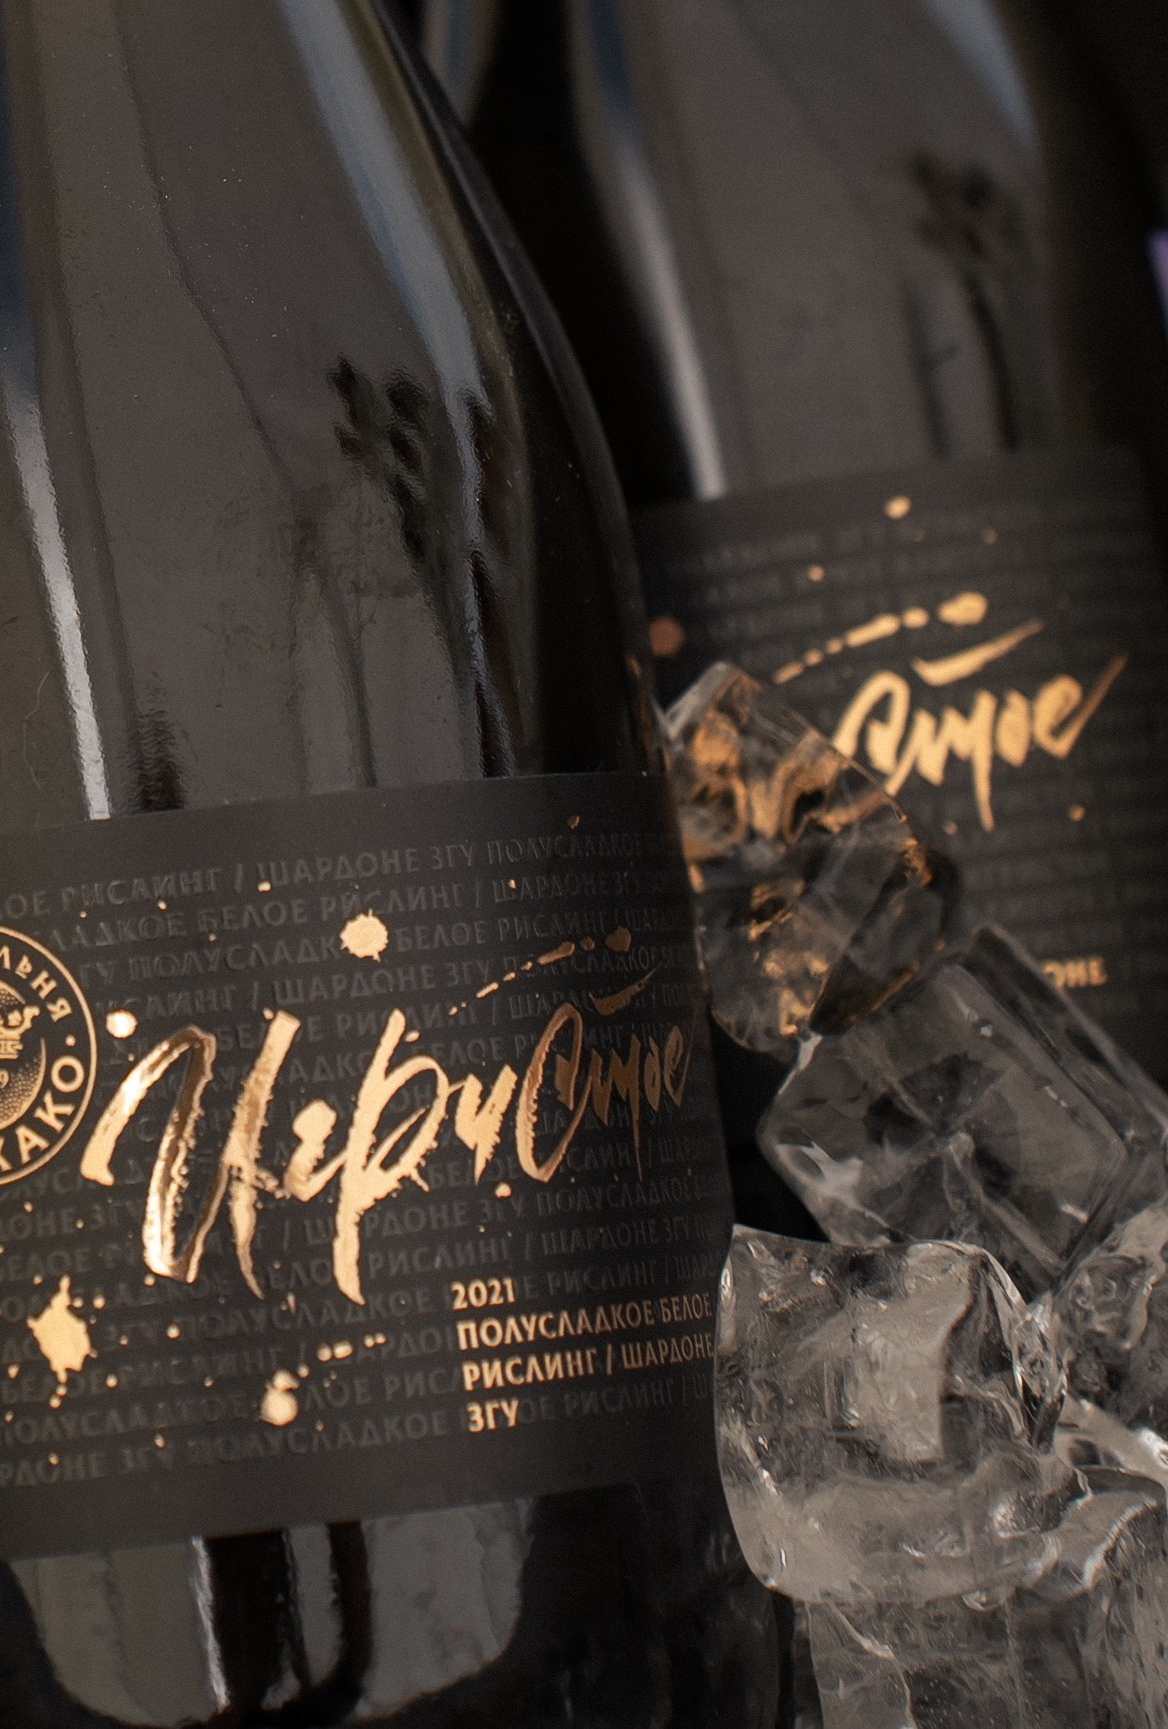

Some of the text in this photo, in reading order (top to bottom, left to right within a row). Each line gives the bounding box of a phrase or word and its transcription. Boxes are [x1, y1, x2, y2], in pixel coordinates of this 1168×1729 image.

[60, 868, 223, 909] РИСЛИНГ
[257, 848, 420, 887] ШАРДОНЕ
[430, 841, 477, 870] ЗГУ
[197, 898, 308, 932] БЕЛОЕ
[396, 920, 486, 952] БЕЛОЕ
[274, 964, 436, 1006] ШАРДОНЕ
[367, 1237, 510, 1279] РИСЛИНГ
[541, 1219, 658, 1255] ШАРДОНЕ
[451, 1276, 515, 1310] 2021
[456, 1291, 712, 1351] ПОЛУСЛАДКОЕ БЕЛОЕ
[462, 1348, 597, 1391] РИСЛИНГ
[606, 1343, 613, 1375] /
[621, 1333, 714, 1370] ШАРДОНЕ
[187, 1410, 446, 1465] ПОЛУСЛАДКОЕ
[466, 1397, 519, 1432] ЗГУ
